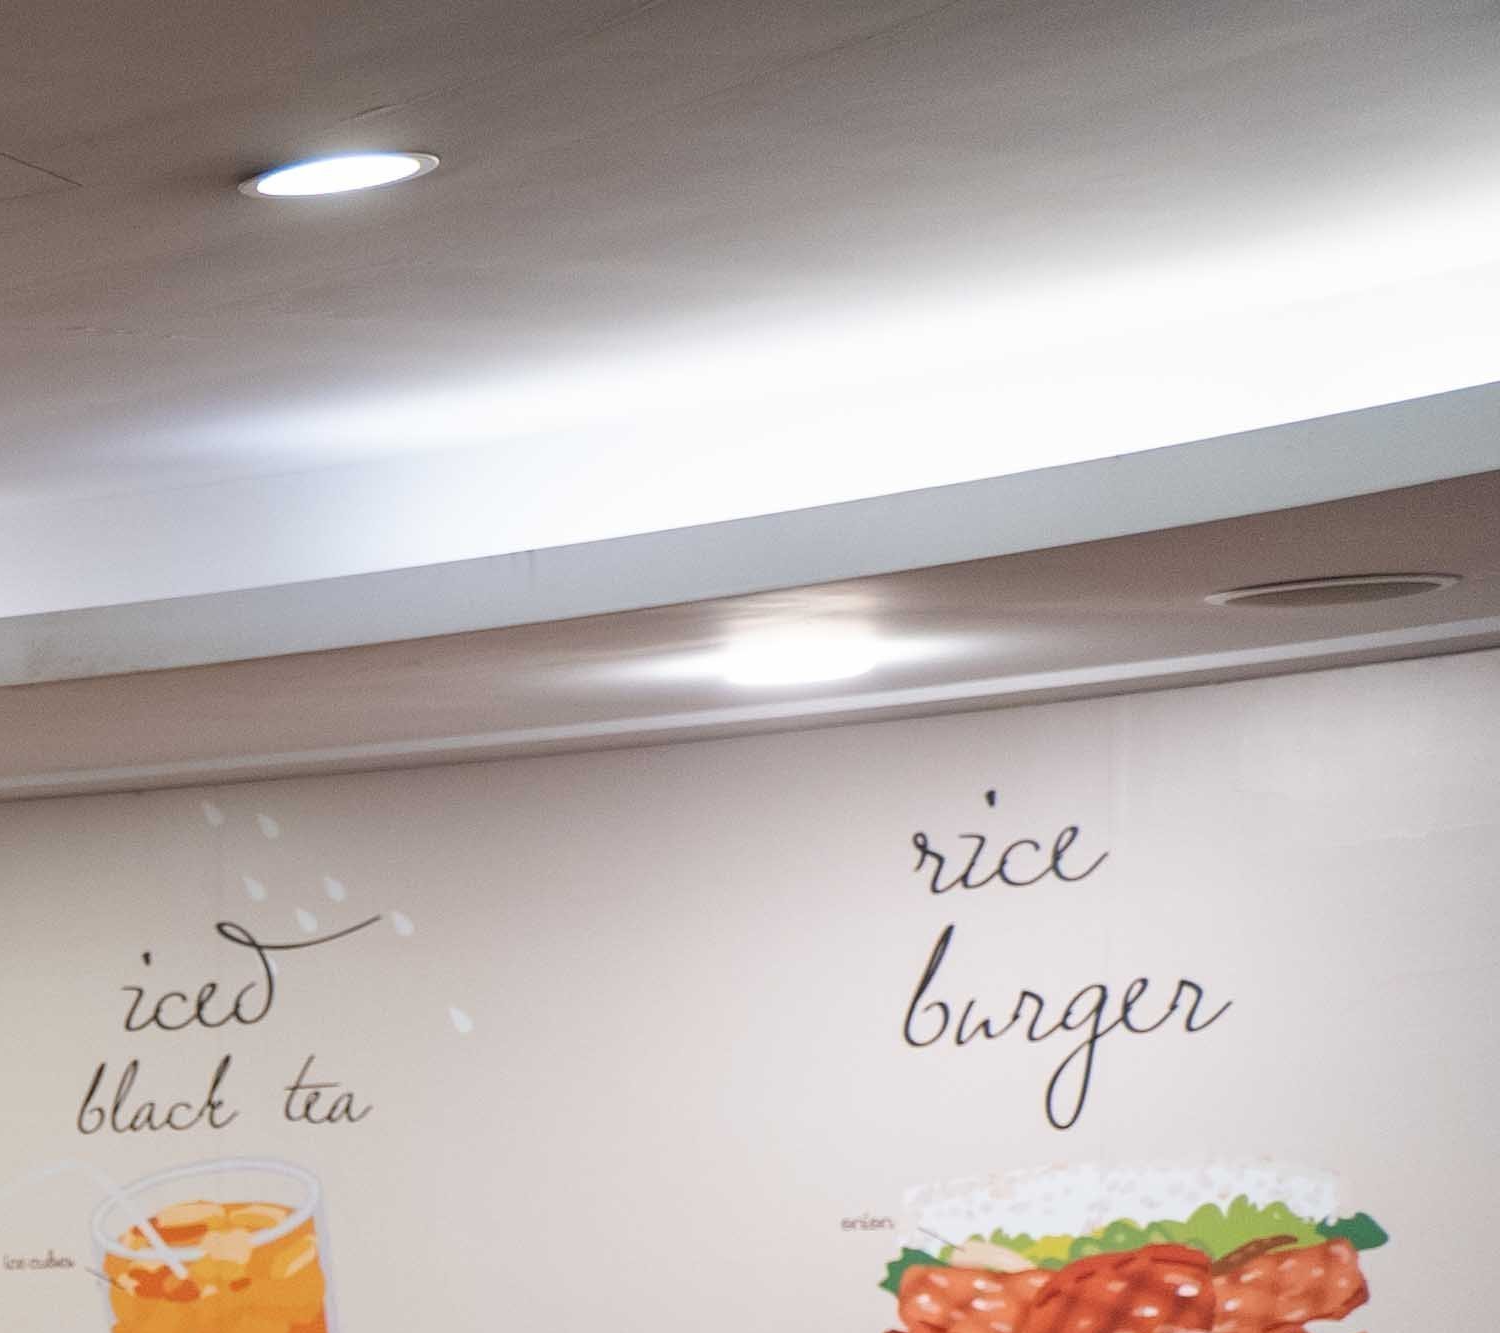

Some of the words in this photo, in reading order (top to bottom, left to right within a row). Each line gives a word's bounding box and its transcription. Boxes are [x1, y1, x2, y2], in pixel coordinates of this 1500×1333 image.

[911, 788, 1110, 894] rice
[120, 914, 382, 1032] iced
[901, 924, 1235, 1130] burger
[77, 1054, 241, 1135] black
[284, 1054, 374, 1126] tea
